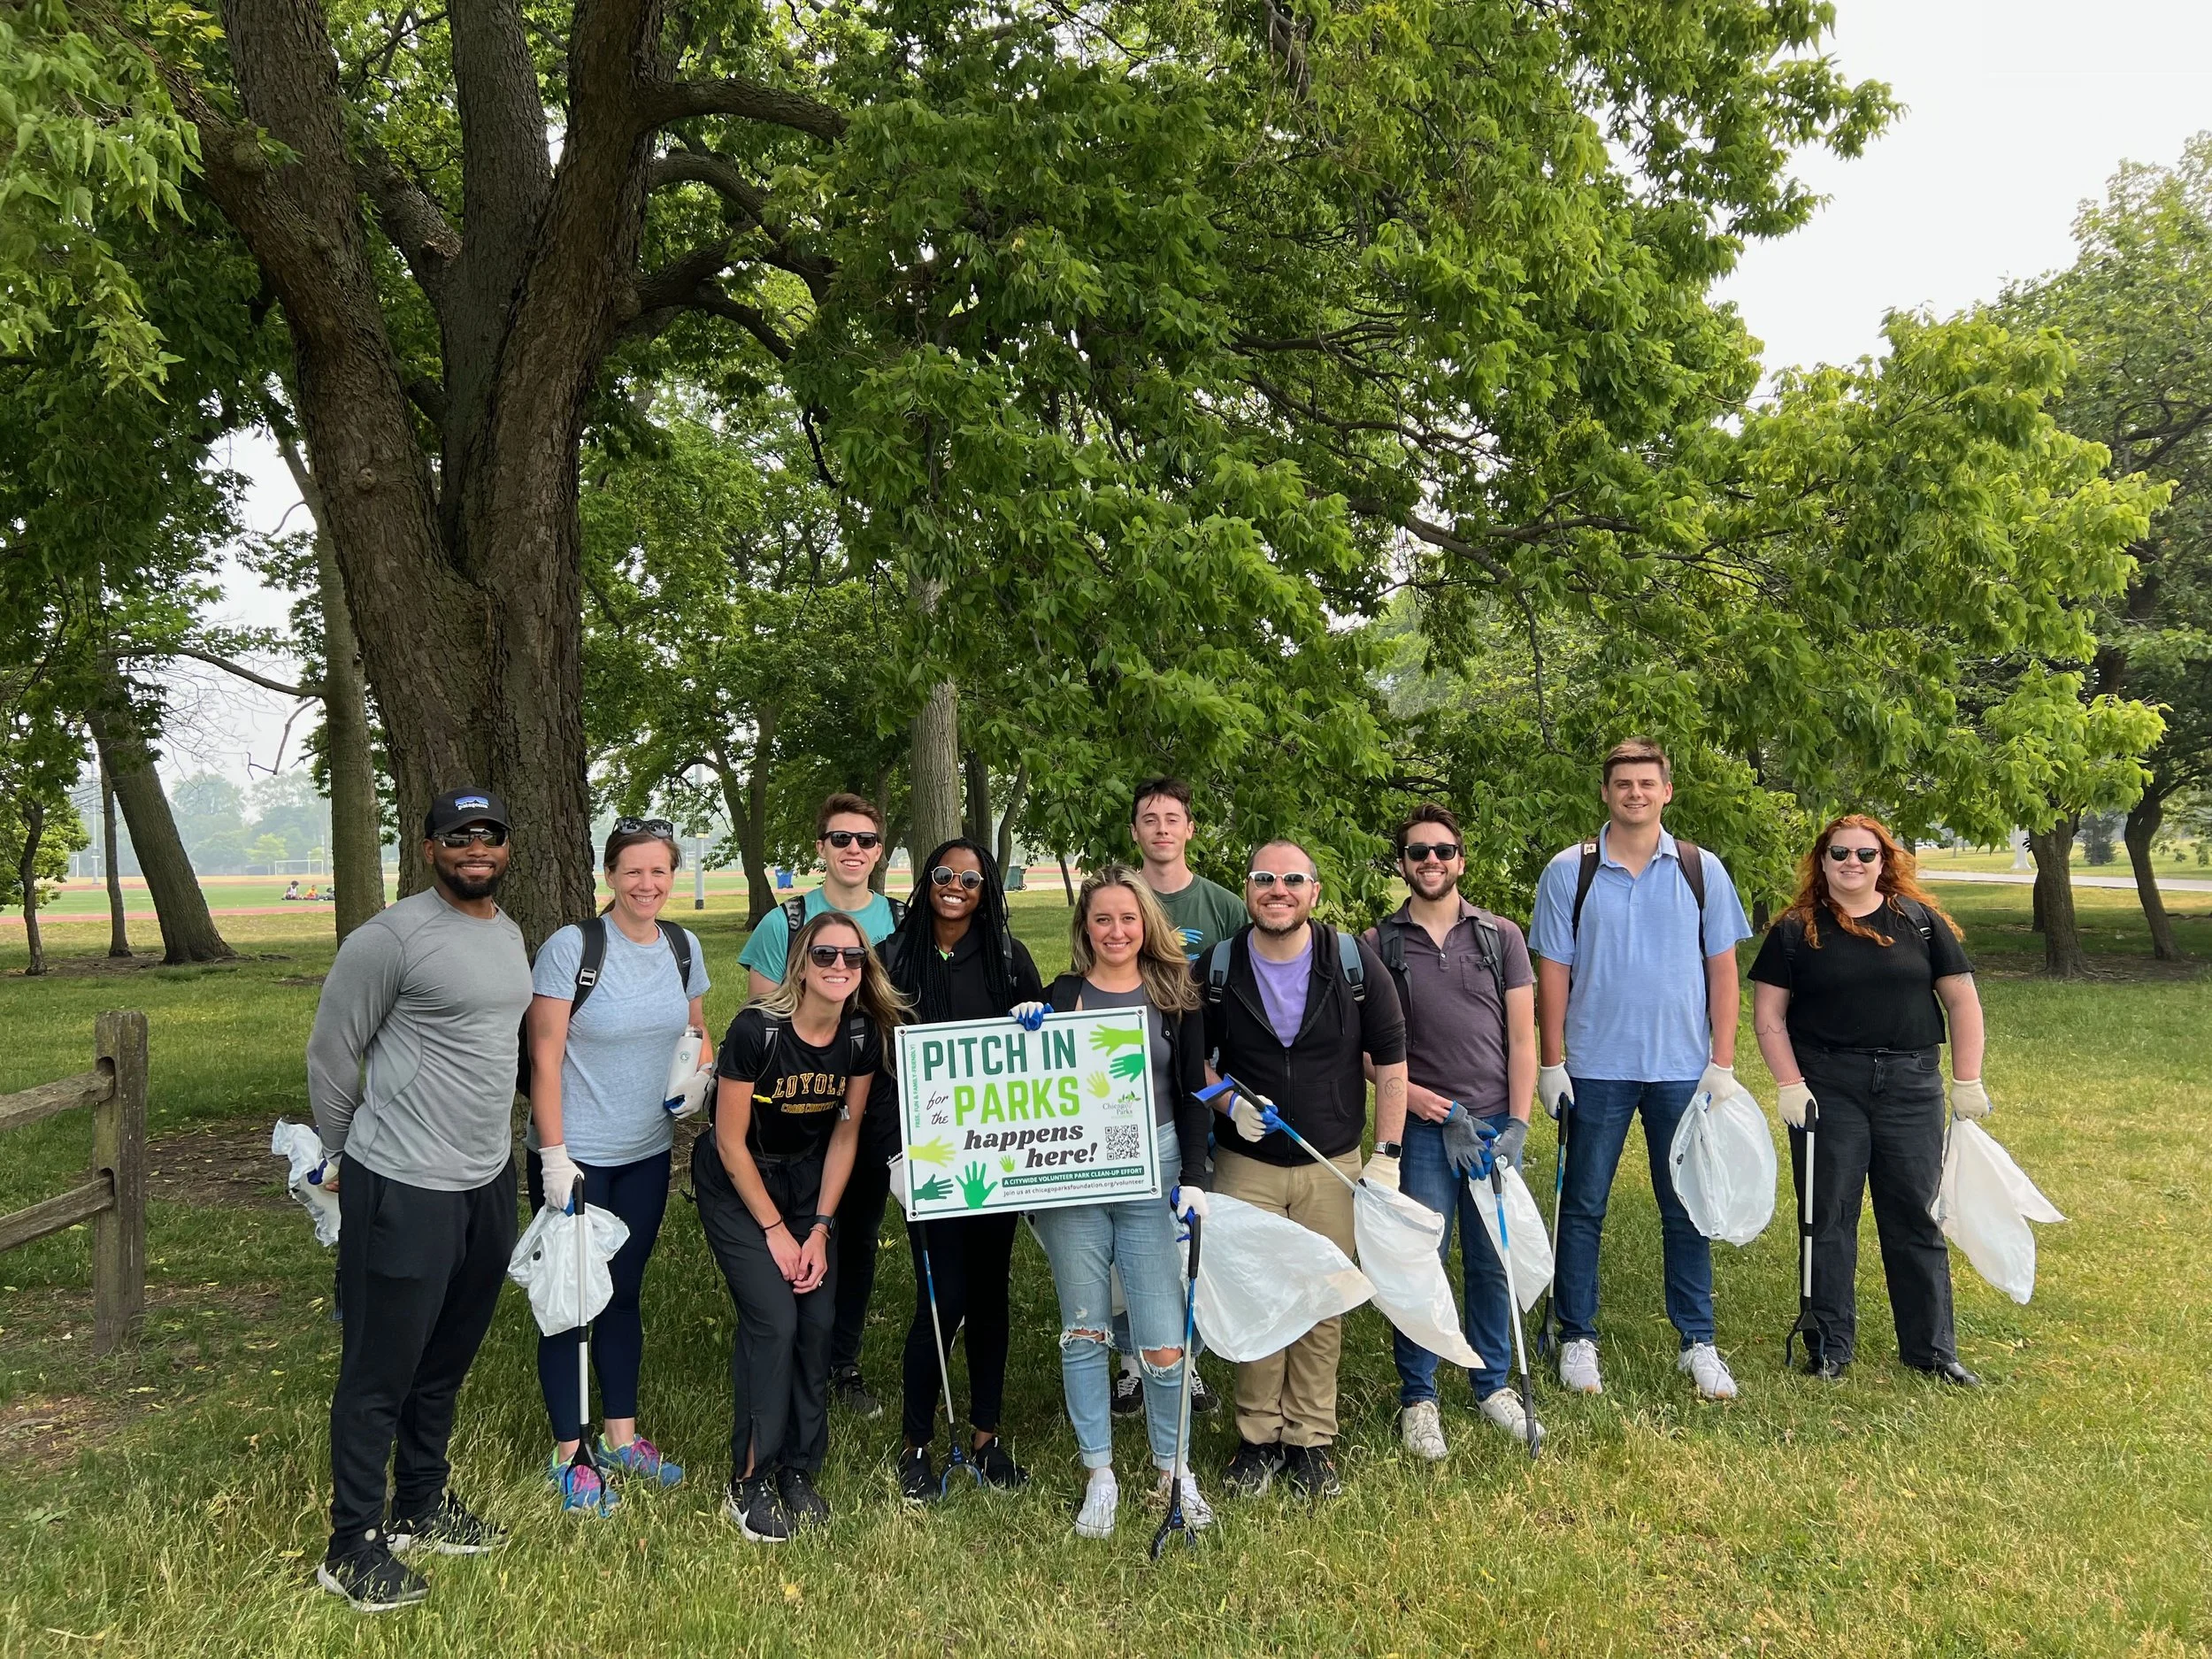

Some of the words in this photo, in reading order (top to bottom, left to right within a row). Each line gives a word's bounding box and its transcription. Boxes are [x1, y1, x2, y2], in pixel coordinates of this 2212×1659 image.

[923, 1033, 1028, 1081] PITCH
[1041, 1028, 1077, 1071] IN
[772, 1072, 846, 1099] LOYOLA
[926, 1091, 949, 1110] for
[954, 1076, 1080, 1126] PARKS
[931, 1110, 949, 1125] the
[964, 1125, 1084, 1152] happens
[1025, 1142, 1098, 1168] here!
[1010, 1177, 1038, 1186] CITYWIDE
[1038, 1173, 1073, 1183] VOLUNTEER
[1090, 1170, 1120, 1179] CLEAN-UP
[1032, 1179, 1144, 1194] chicagoparksfoundation.org/volunteer
